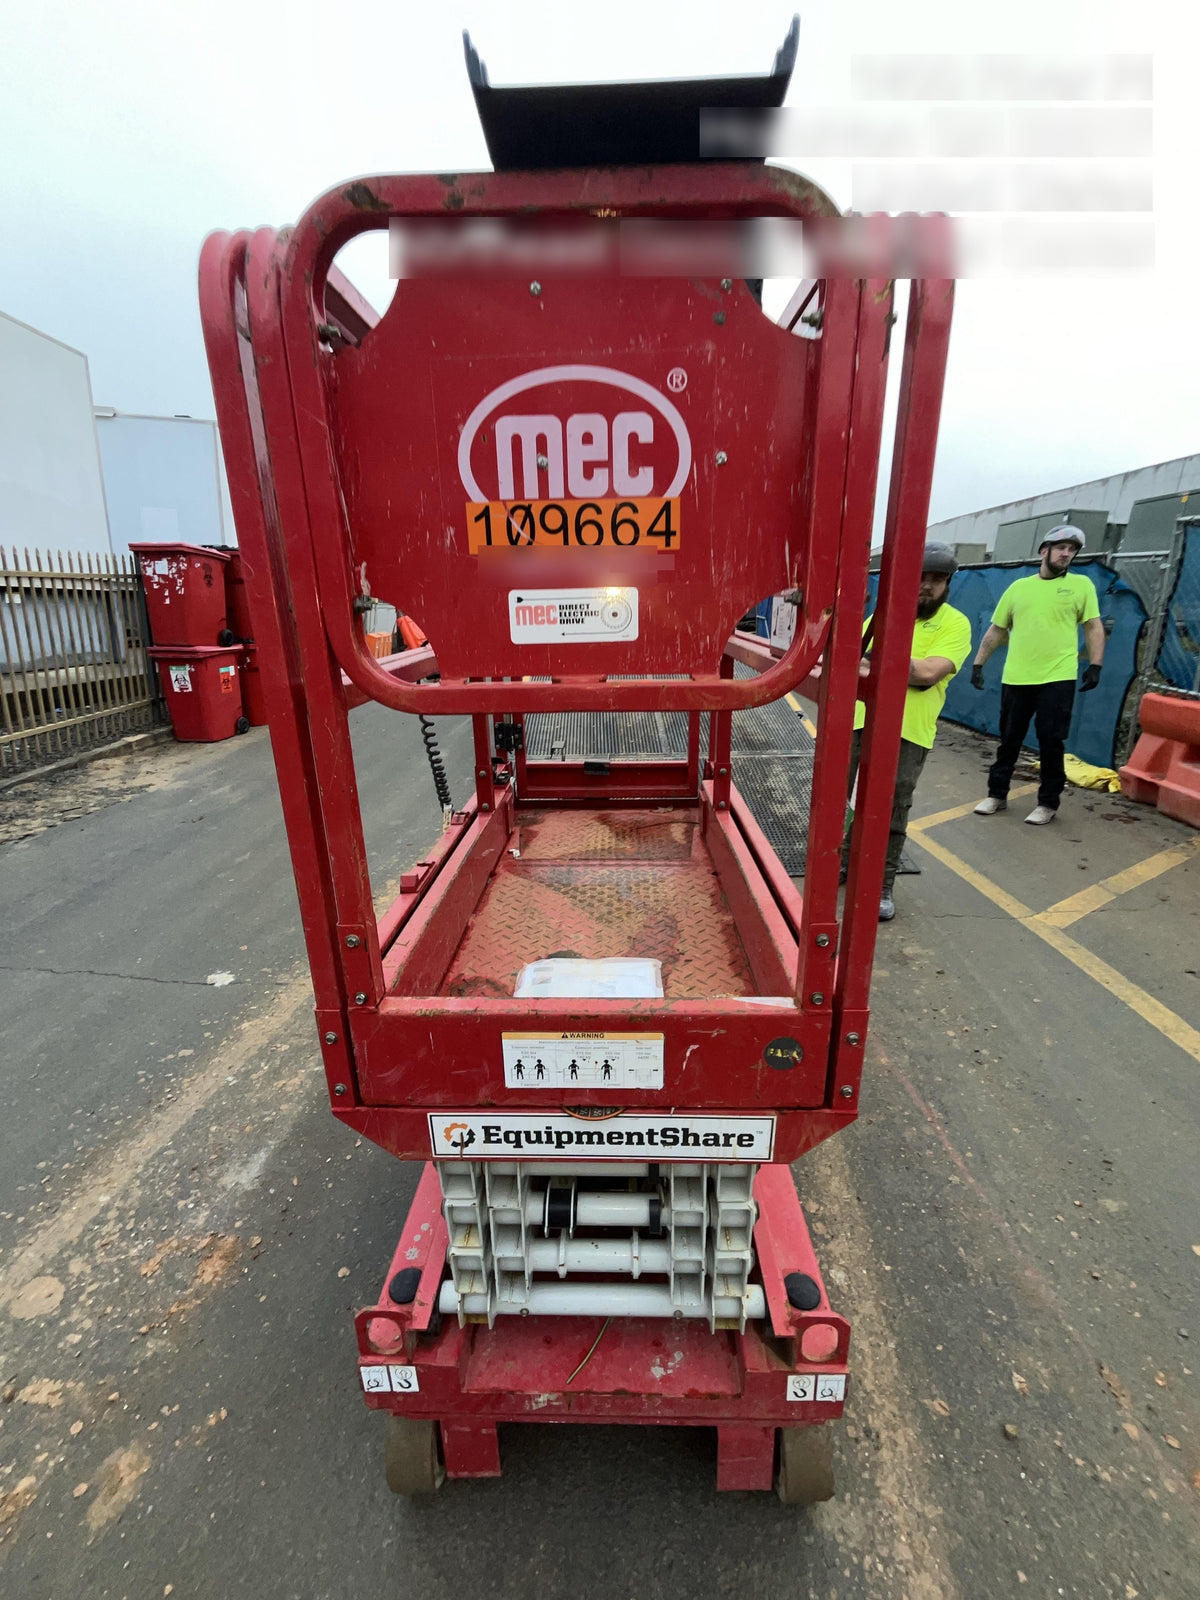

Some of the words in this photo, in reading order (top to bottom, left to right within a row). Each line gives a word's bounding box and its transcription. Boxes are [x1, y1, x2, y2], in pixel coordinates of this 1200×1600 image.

[473, 500, 677, 548] 109664
[558, 603, 591, 611] DIRECT
[558, 610, 600, 618] ELECTRIC
[481, 1125, 755, 1149] EquipmentShare
